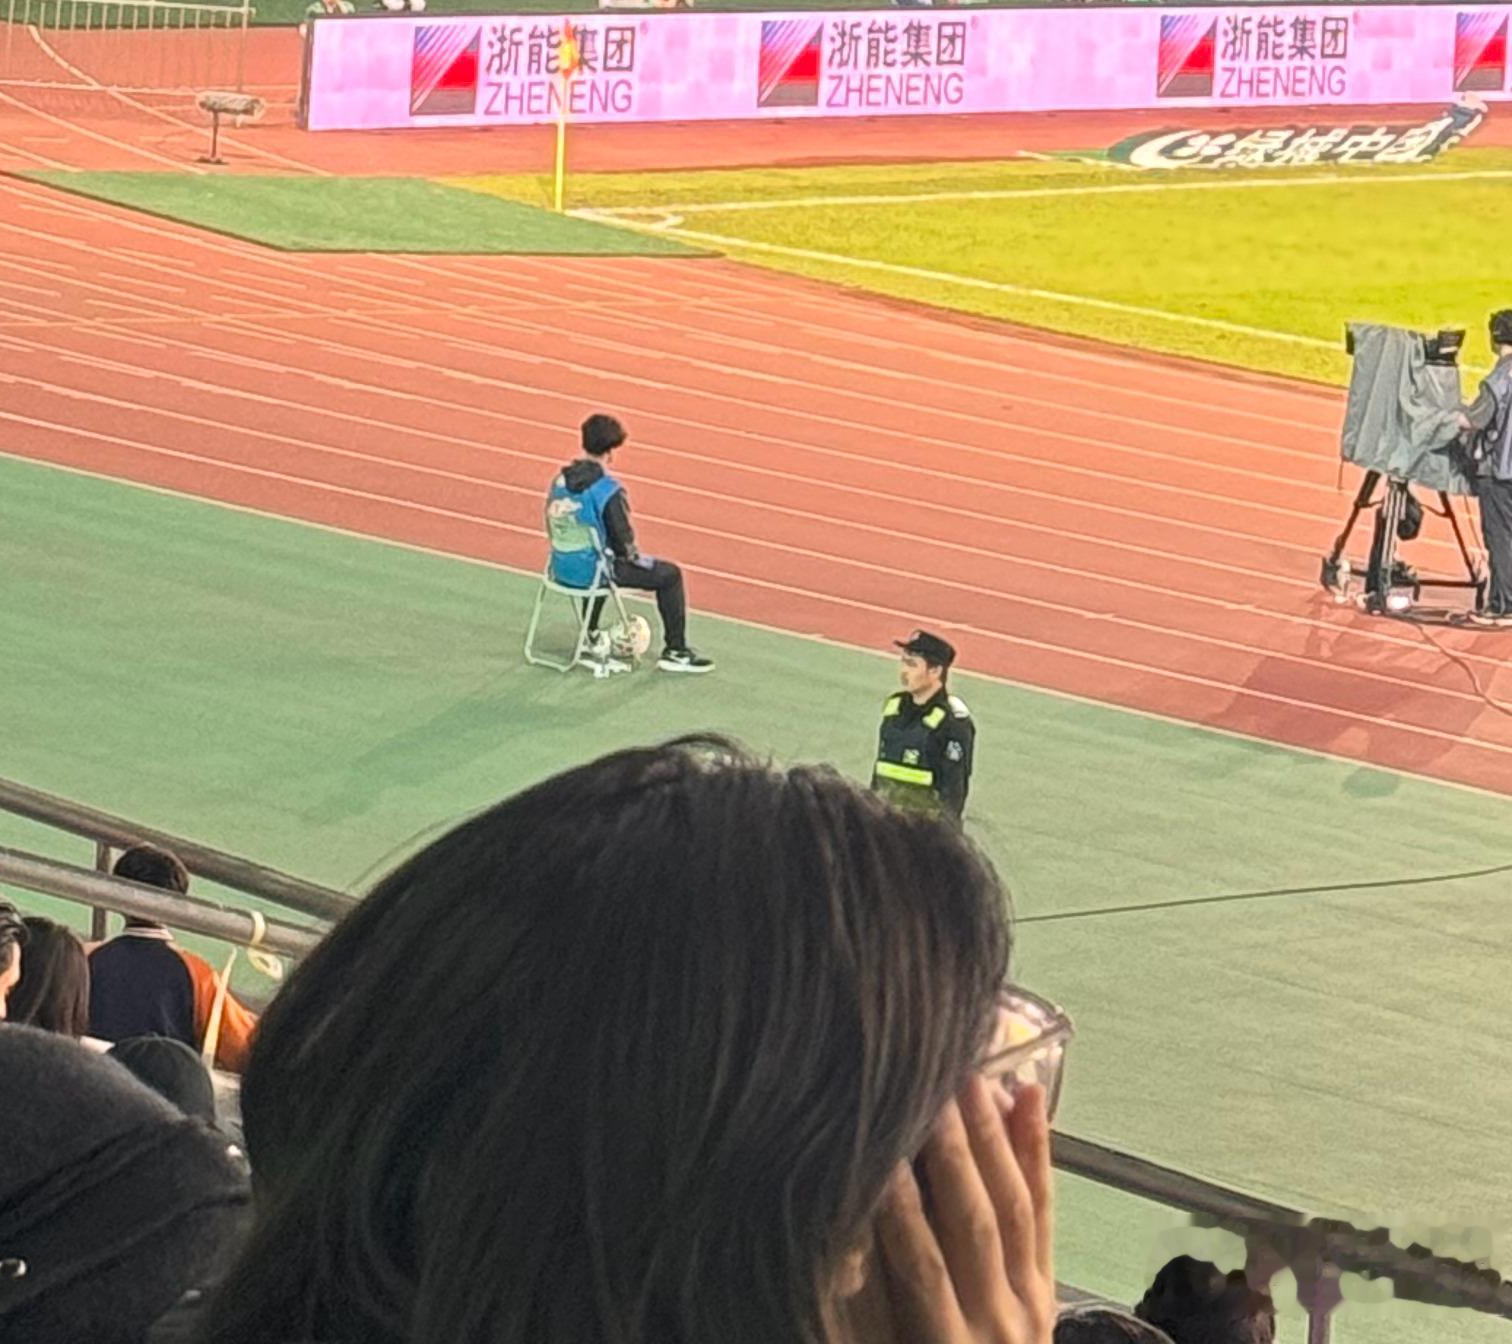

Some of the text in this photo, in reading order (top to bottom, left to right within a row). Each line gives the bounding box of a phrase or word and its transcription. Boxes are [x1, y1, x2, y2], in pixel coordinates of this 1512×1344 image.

[486, 23, 636, 76] 浙能集团
[827, 19, 967, 69] 浙能集团
[1221, 14, 1349, 62] 浙能集团
[483, 79, 633, 115] ZHENENG
[826, 72, 964, 108] ZHENENG
[1219, 65, 1347, 99] ZHENENG
